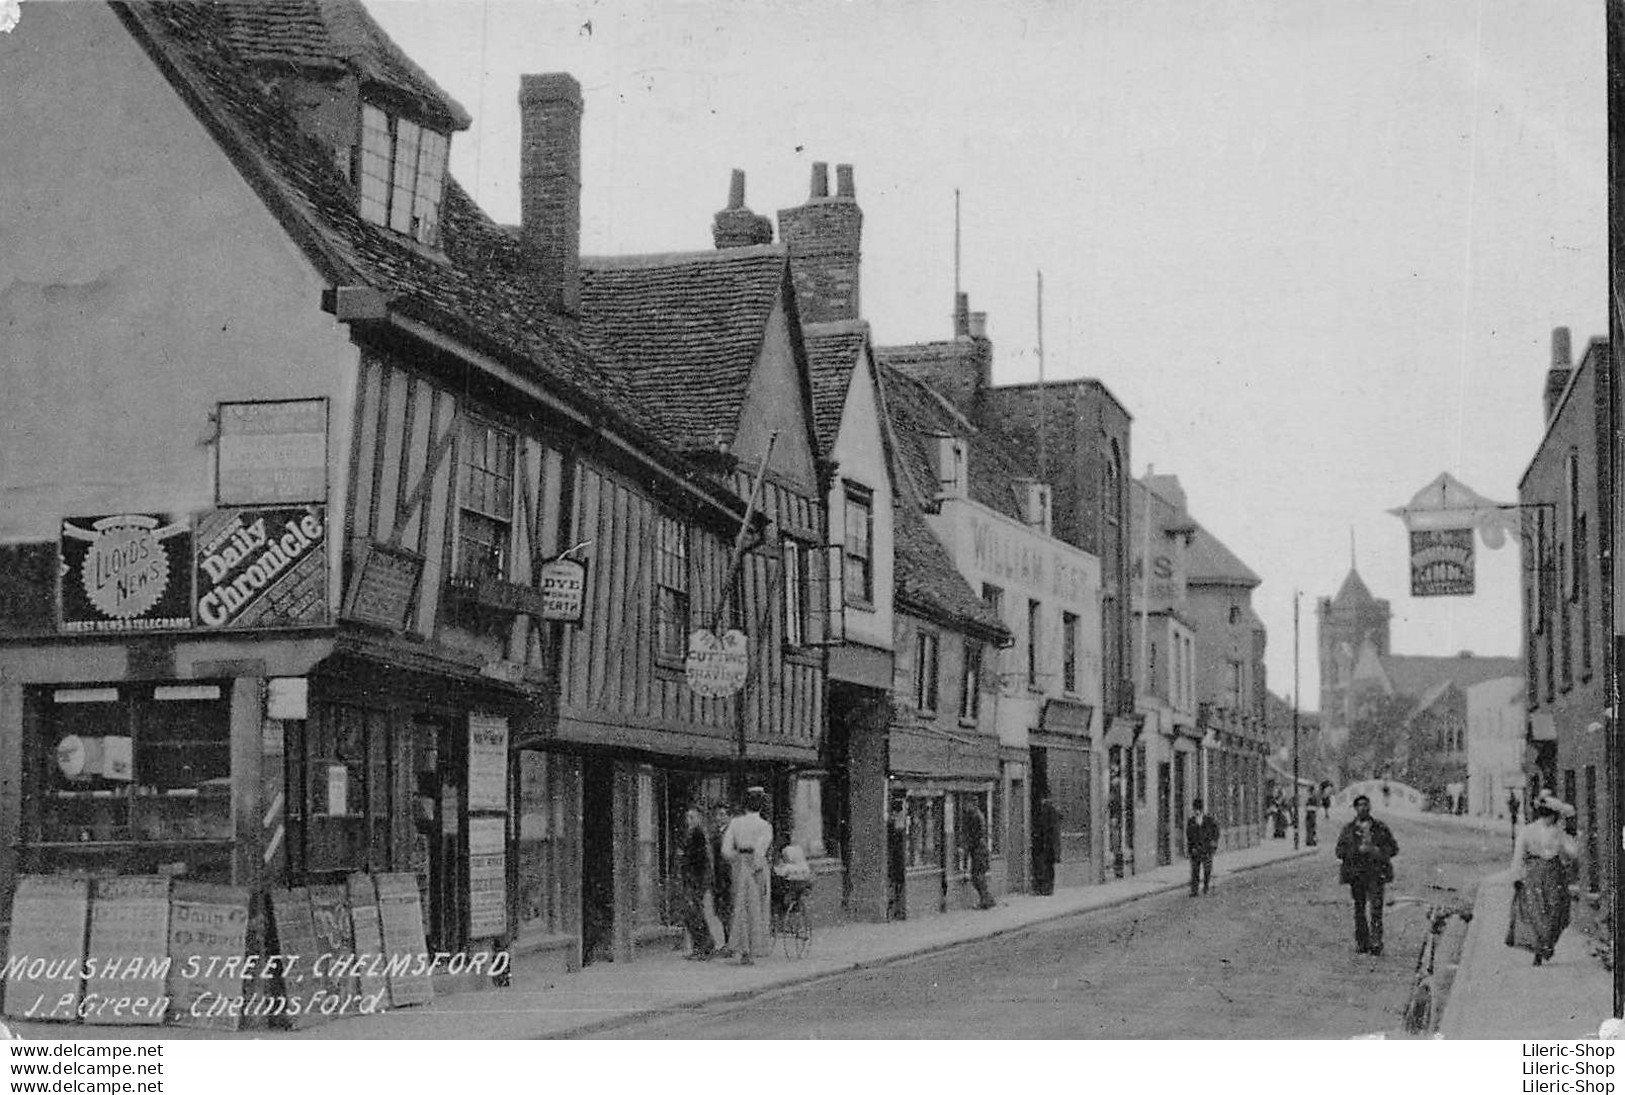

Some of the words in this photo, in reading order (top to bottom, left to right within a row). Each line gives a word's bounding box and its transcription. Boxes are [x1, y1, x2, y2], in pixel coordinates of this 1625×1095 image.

[199, 515, 323, 626] Chronicle
[200, 518, 266, 585] Daily
[544, 578, 580, 590] DYE
[688, 649, 747, 663] CUTTING
